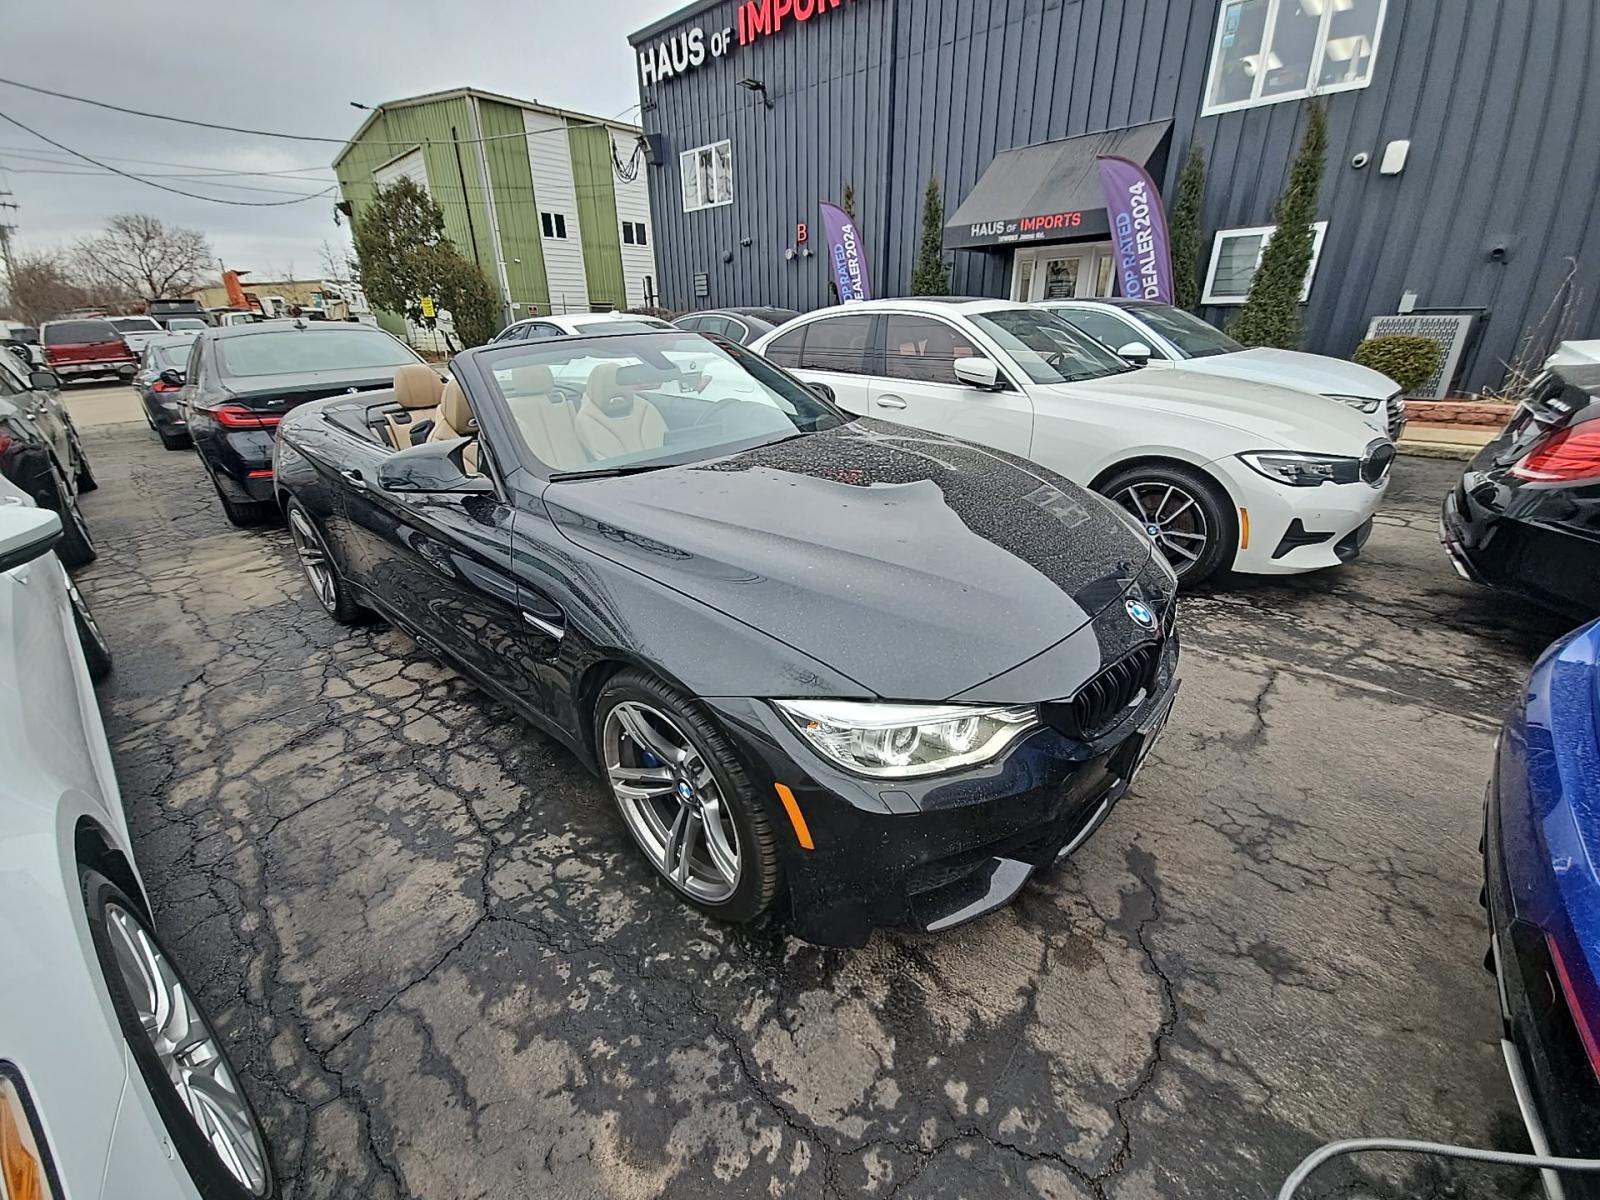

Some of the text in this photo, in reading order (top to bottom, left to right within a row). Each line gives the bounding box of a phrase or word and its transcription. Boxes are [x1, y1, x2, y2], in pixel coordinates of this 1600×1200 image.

[639, 0, 840, 87] HAUS OF IMP
[797, 223, 807, 241] B
[970, 221, 1005, 237] HAUS
[1006, 223, 1017, 233] OF
[1020, 212, 1082, 231] IMPORTS
[1116, 212, 1137, 270] RATED
[834, 243, 851, 285] RATED
[842, 223, 864, 300] EALER 2024
